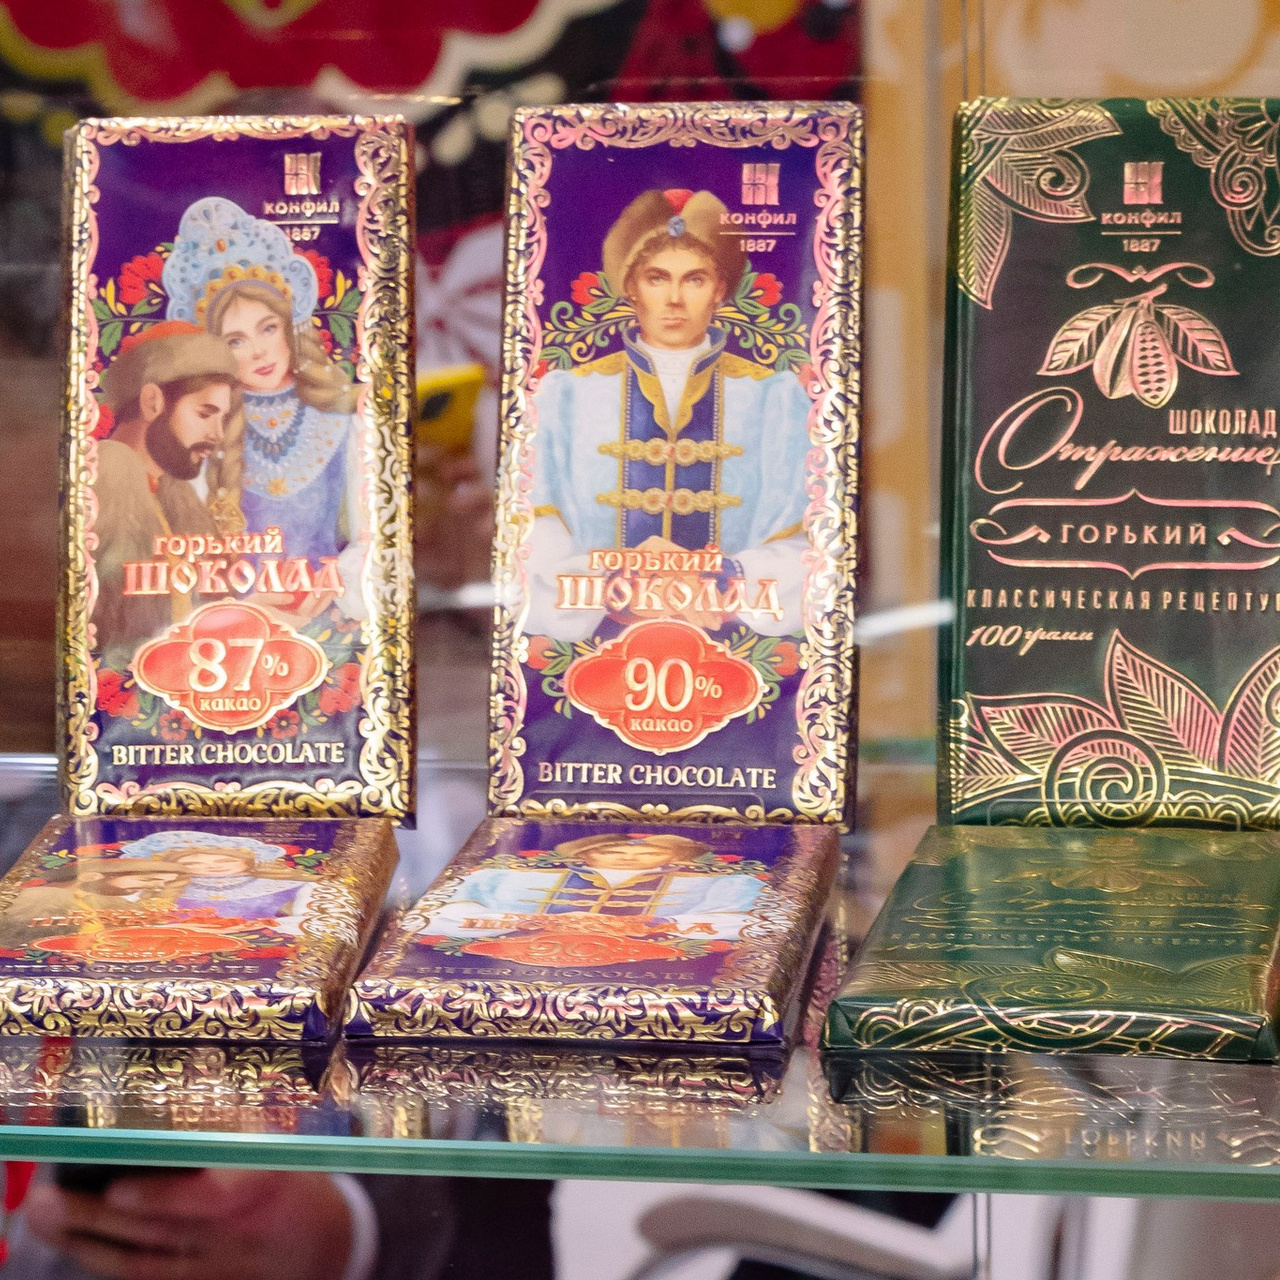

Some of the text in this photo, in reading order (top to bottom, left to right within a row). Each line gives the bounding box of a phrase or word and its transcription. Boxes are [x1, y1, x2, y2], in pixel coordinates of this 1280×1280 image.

[263, 198, 340, 218] конфил
[719, 209, 797, 228] конфил
[1101, 208, 1182, 228] конфил
[284, 226, 321, 241] 1887
[740, 239, 776, 253] 1887
[1122, 239, 1161, 253] 1887
[1168, 408, 1278, 439] ШОКОЛАД
[974, 385, 1280, 492] Отражение
[154, 526, 284, 563] горький
[1060, 522, 1208, 545] ГОРЬКИЙ
[590, 544, 724, 579] горький
[123, 557, 345, 598] ШОКОЛАД
[556, 574, 785, 620] ШОКОЛАД
[965, 587, 1151, 610] КЛАССИЧЕСКАЯ
[188, 637, 289, 693] 87%
[624, 656, 723, 713] 90%
[199, 696, 262, 712] какао
[630, 716, 694, 733] какао
[112, 741, 346, 766] BITTER CHOCOLATE
[538, 761, 777, 789] BITTER CHOCOLATE
